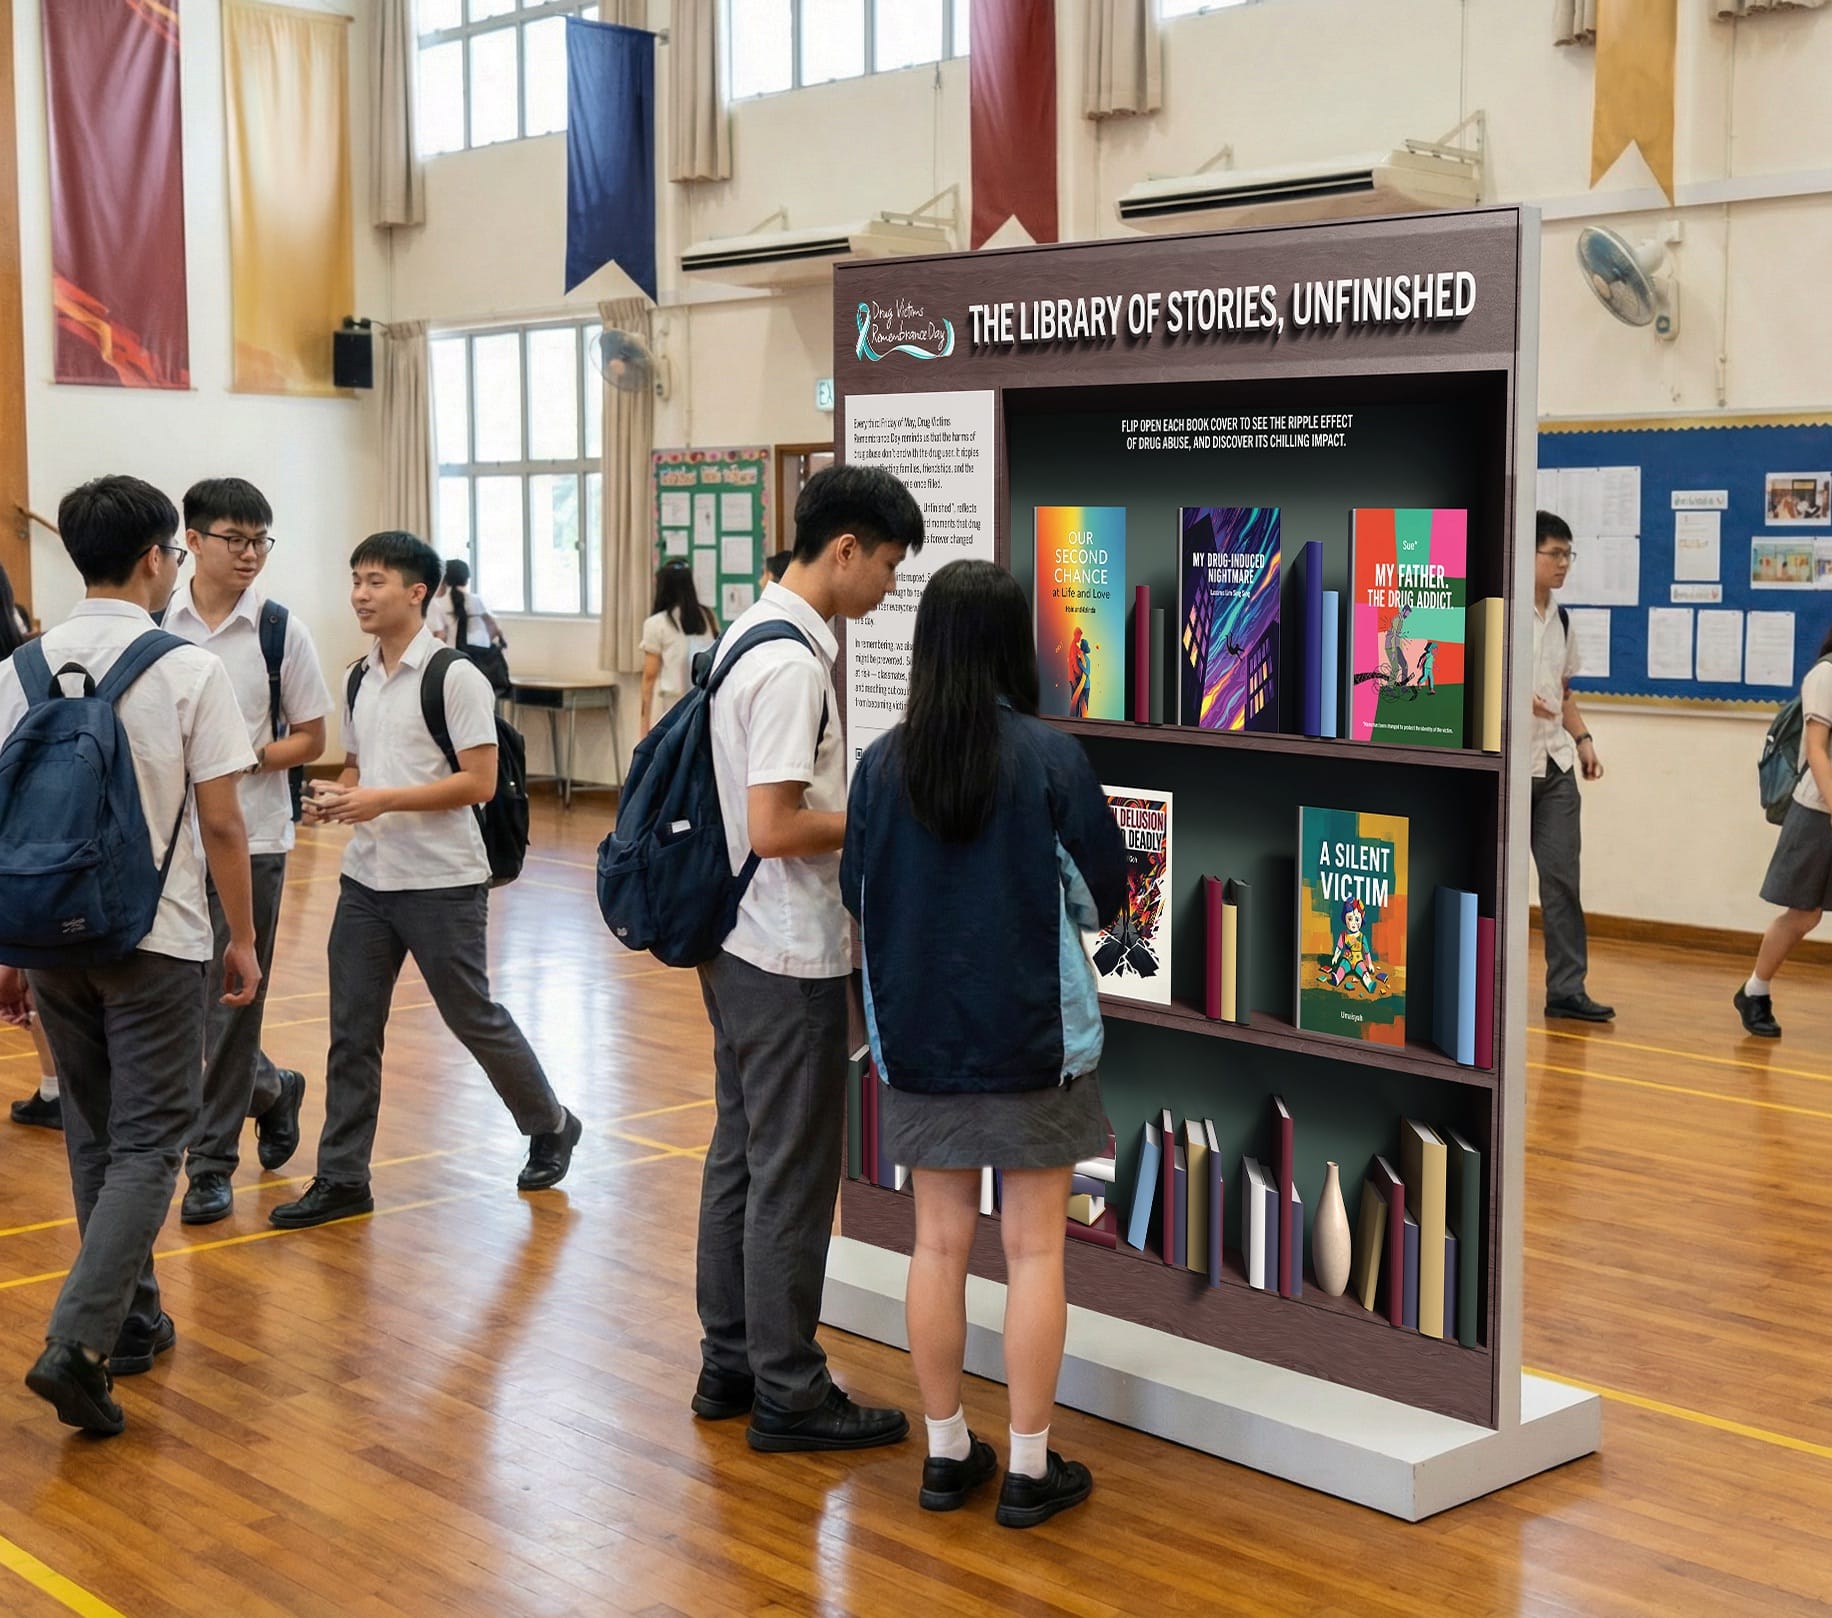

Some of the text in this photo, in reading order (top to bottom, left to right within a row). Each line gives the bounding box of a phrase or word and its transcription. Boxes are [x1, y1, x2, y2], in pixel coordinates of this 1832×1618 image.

[872, 298, 924, 329] Drug Victims
[968, 270, 1477, 344] THE LIBRARY OF STORIES, UNFINISHED
[872, 319, 945, 351] Remembrance Day
[1122, 414, 1354, 432] FLIP OPEN EACH BOOK COVER TO SEE THE RIPPLE EFFECT
[1126, 433, 1346, 452] OF DRUG ABUSE, AND DISCOVER ITS CHILLING IMPACT.
[1069, 530, 1094, 544] OUR
[1055, 548, 1108, 564] SECOND
[1192, 552, 1264, 568] MY DRUG-INDUCED
[1054, 568, 1108, 584] CHANCE
[1208, 568, 1254, 584] NIGHTMARE
[1376, 564, 1448, 588] MY FATHER.
[1052, 586, 1110, 600] at Life and Love
[1368, 590, 1454, 609] THE DRUG ADDICT.
[1120, 808, 1164, 831] DELUSION
[1128, 830, 1162, 851] DEADLY
[1320, 841, 1390, 873] A SILENT
[1320, 871, 1388, 908] VICTIM
